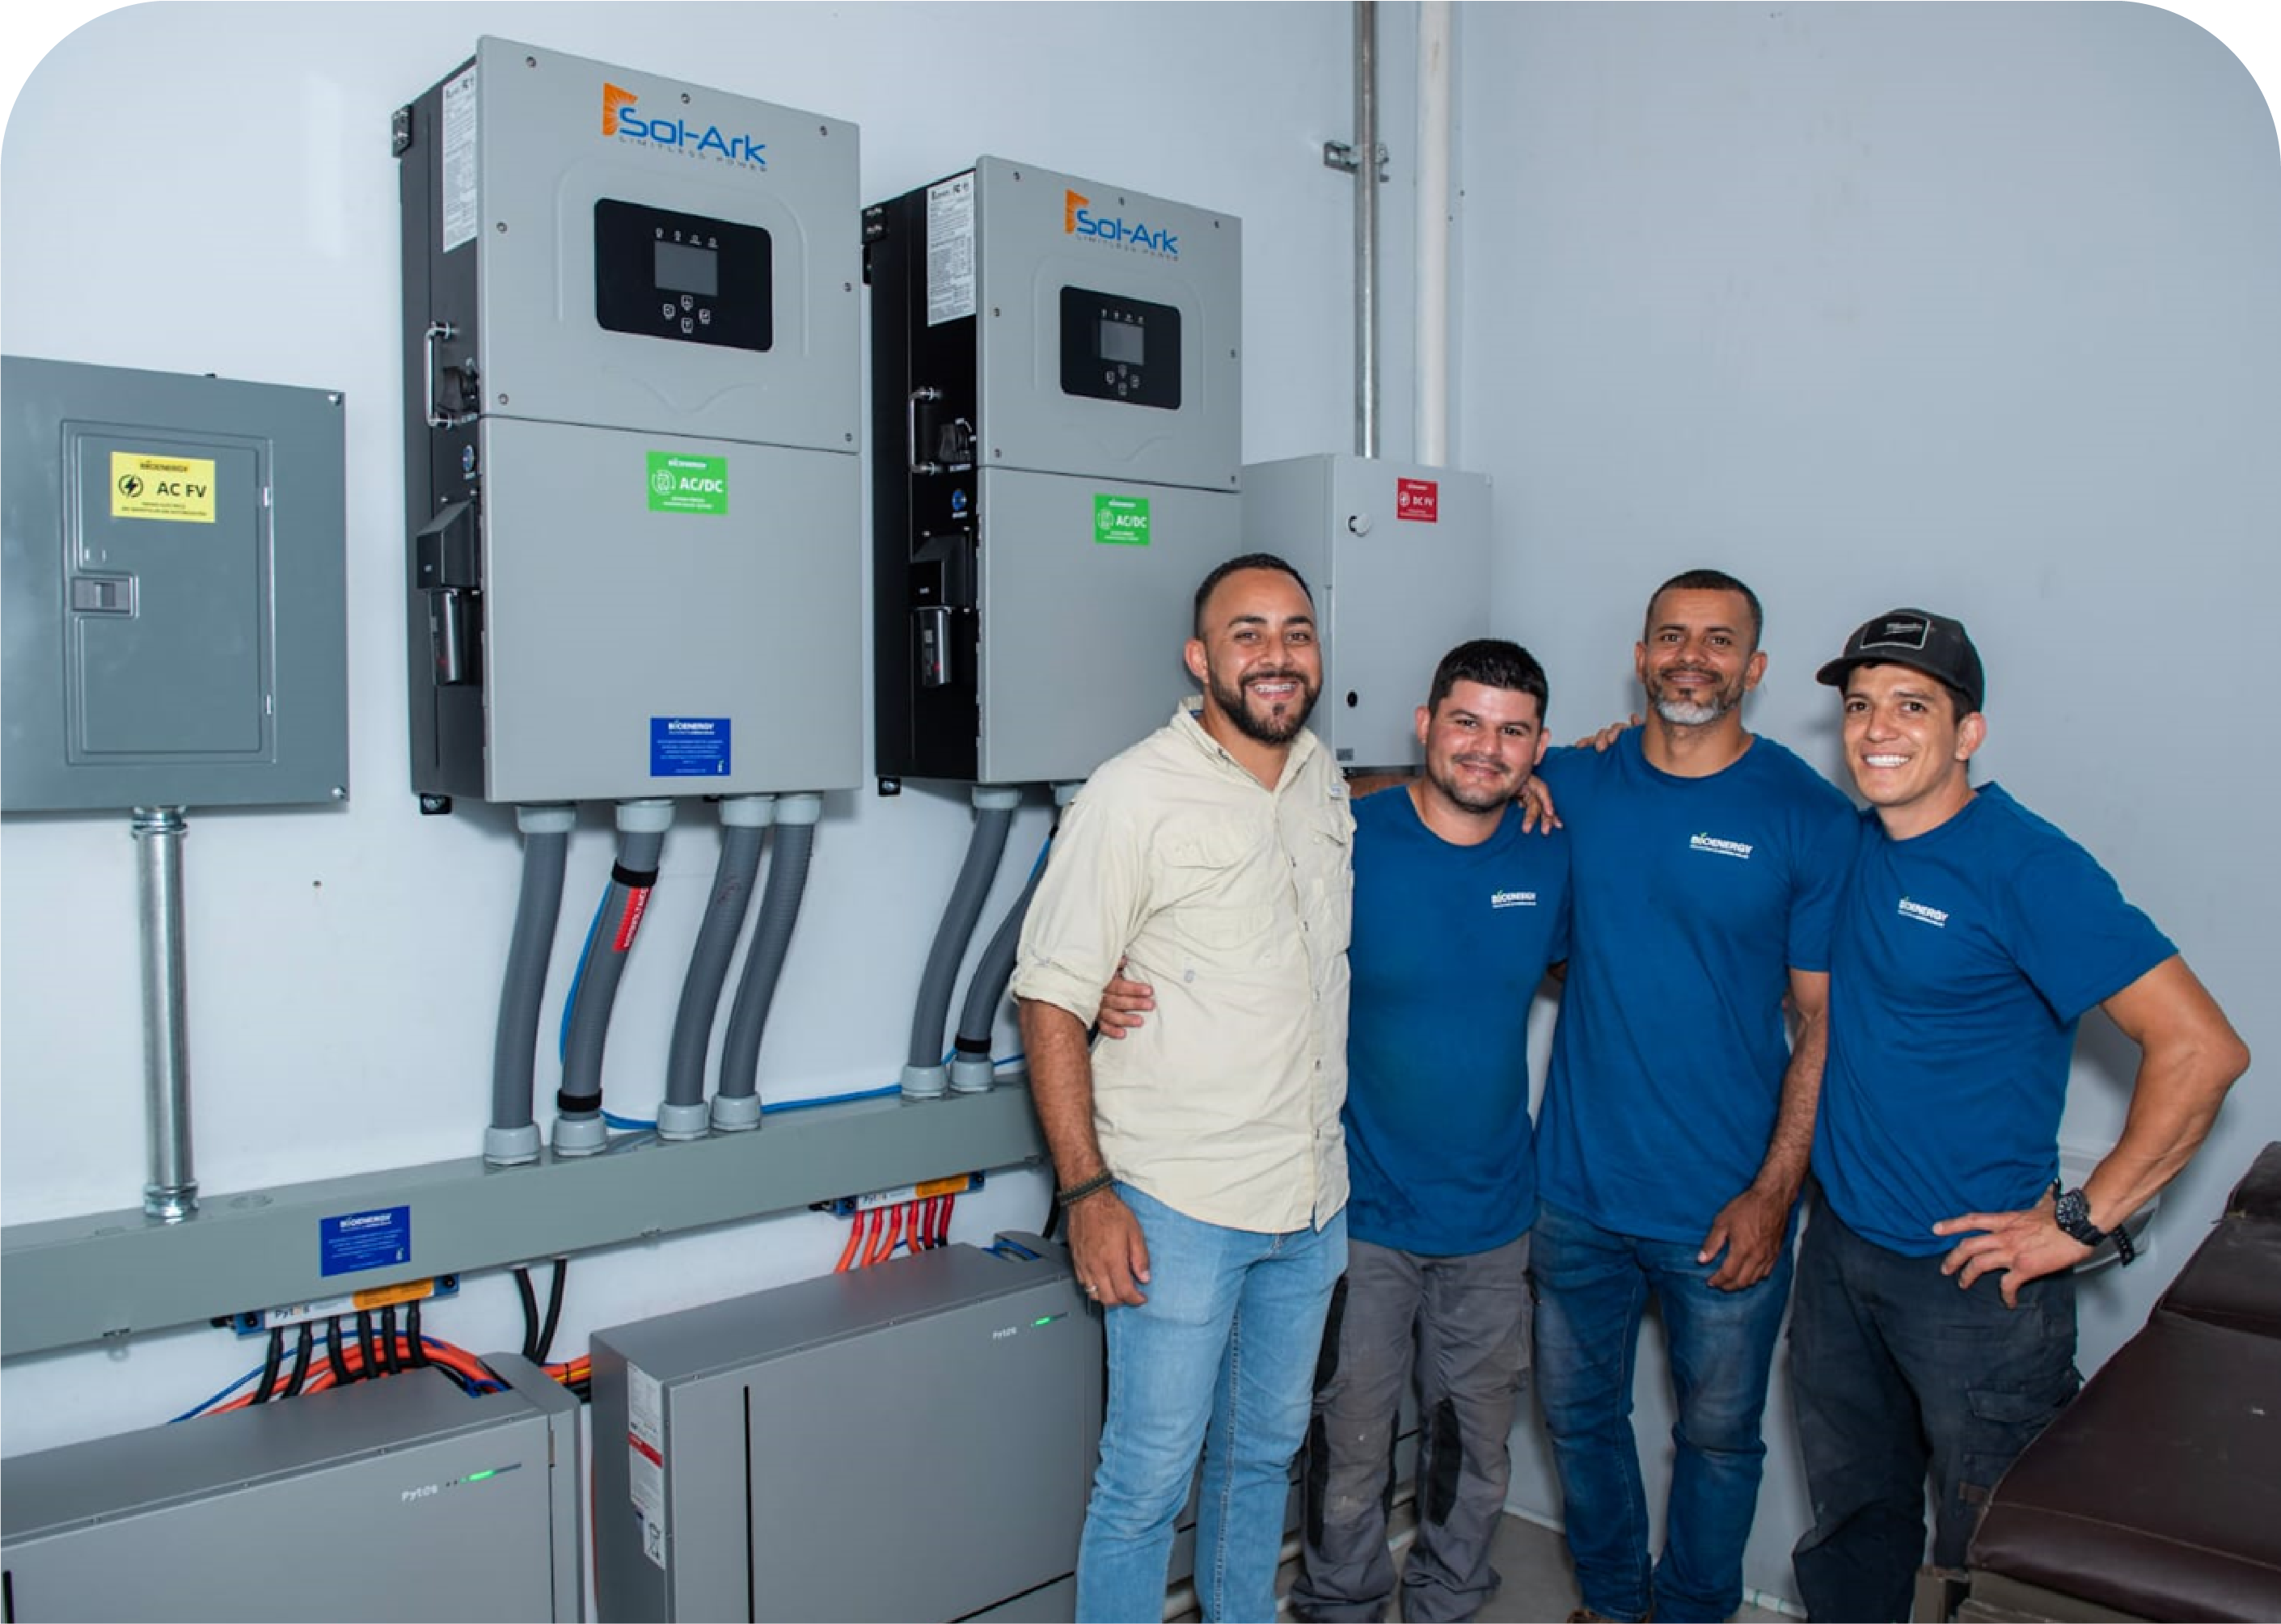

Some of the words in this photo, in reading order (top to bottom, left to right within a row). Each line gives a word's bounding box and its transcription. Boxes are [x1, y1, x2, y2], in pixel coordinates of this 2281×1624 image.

[619, 107, 767, 164] Sol-Ark
[1076, 209, 1178, 258] Sol-Ark
[156, 481, 180, 496] AC
[186, 484, 207, 498] FV
[680, 477, 724, 493] AC/DC
[1413, 496, 1423, 506] DC
[1116, 515, 1147, 528] AC/DC
